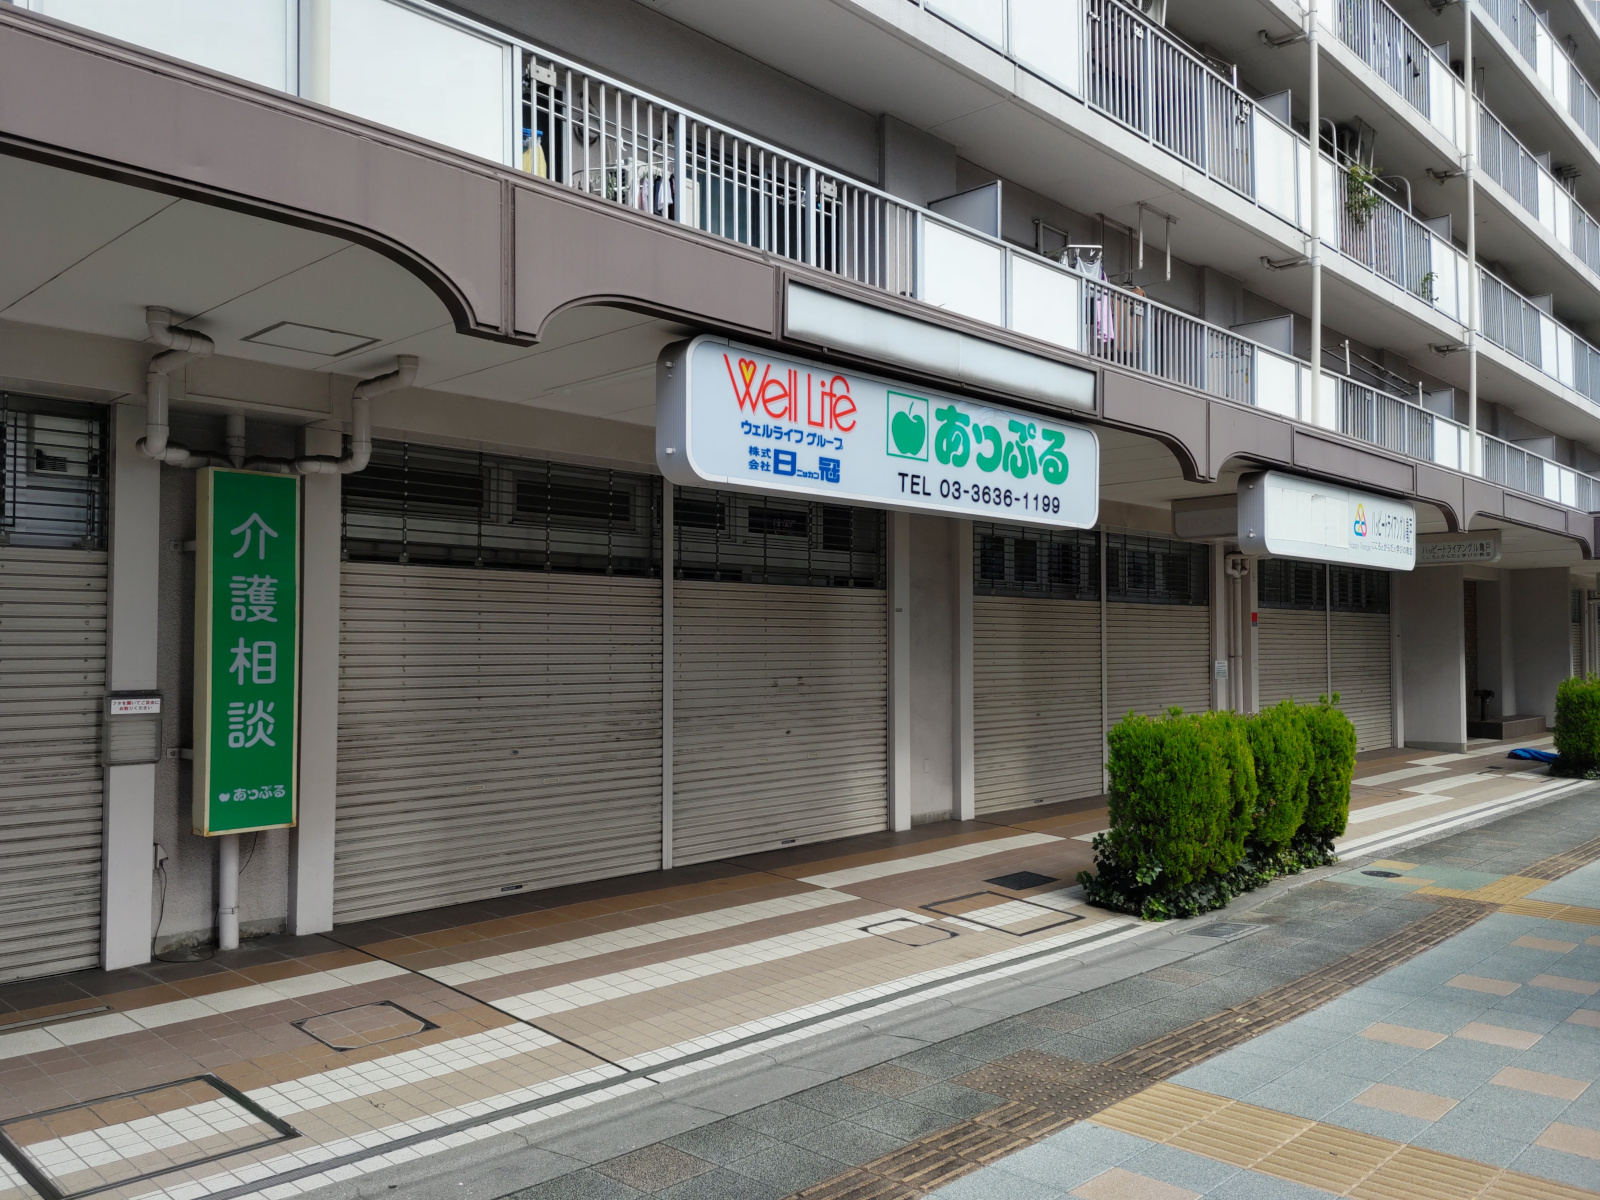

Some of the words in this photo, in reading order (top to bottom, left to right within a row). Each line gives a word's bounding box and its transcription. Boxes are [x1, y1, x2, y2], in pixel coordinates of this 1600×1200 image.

[723, 353, 798, 423] Well
[807, 375, 857, 433] Life
[898, 472, 931, 496] TEL
[940, 479, 1060, 514] 03-3636-1199
[226, 512, 279, 748] 介護相談
